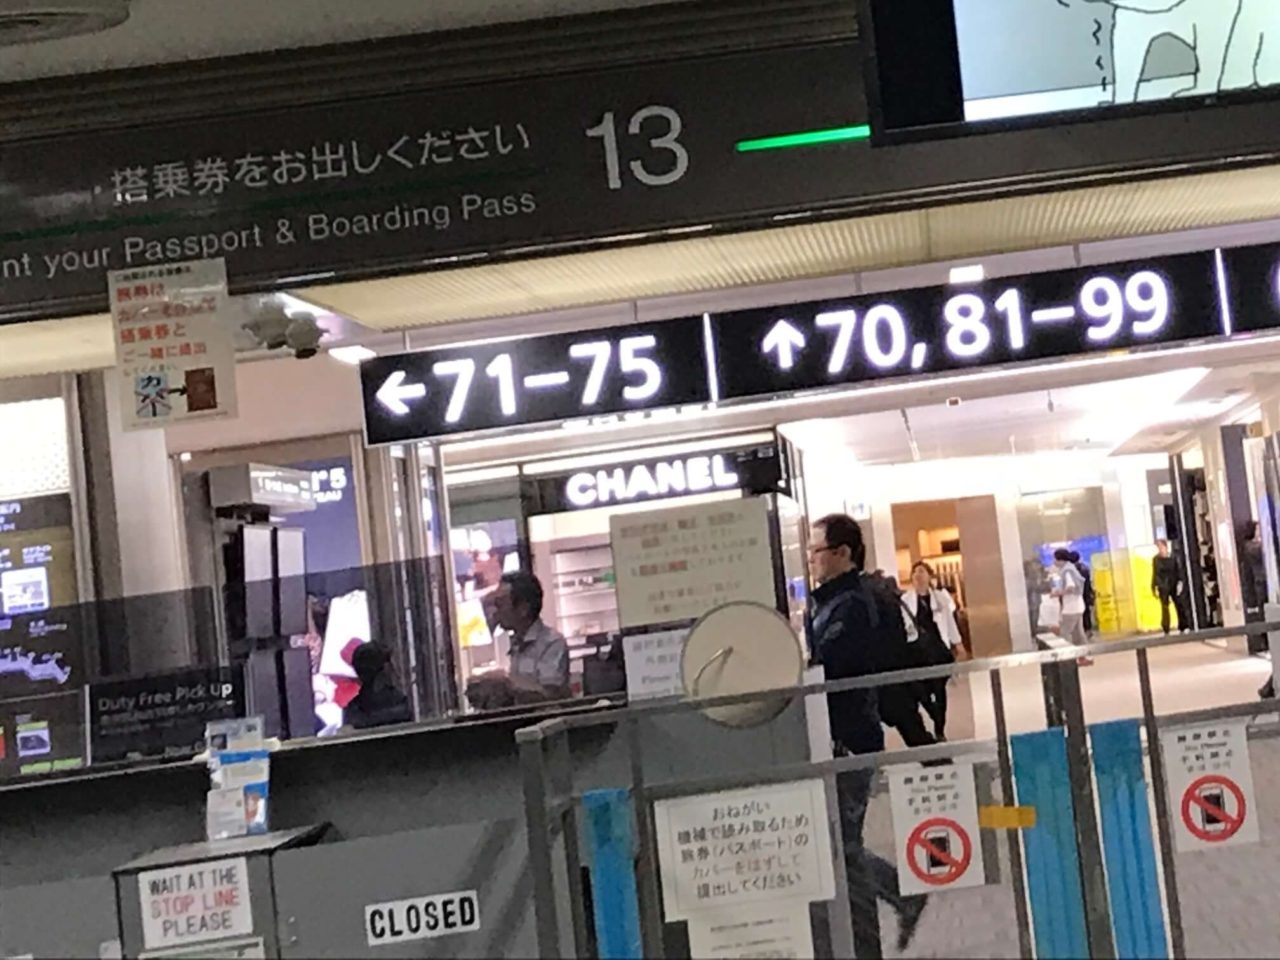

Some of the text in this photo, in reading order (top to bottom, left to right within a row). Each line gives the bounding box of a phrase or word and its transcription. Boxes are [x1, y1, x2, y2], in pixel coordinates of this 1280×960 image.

[586, 105, 689, 190] 13
[44, 244, 110, 280] your
[124, 222, 264, 264] Passport
[275, 219, 296, 242] &
[309, 200, 450, 240] Boarding
[461, 189, 537, 221] Pass
[432, 335, 663, 423] 71-75
[943, 271, 1168, 357] 81-99
[565, 455, 738, 506] CHANEL
[99, 683, 233, 711] Duty Free Pick Up
[712, 800, 771, 821] おねがい
[149, 865, 238, 896] WAIT AT THE
[150, 887, 241, 920] STOP LINE
[369, 896, 476, 939] CLOSED
[162, 910, 232, 937] PLEASE
